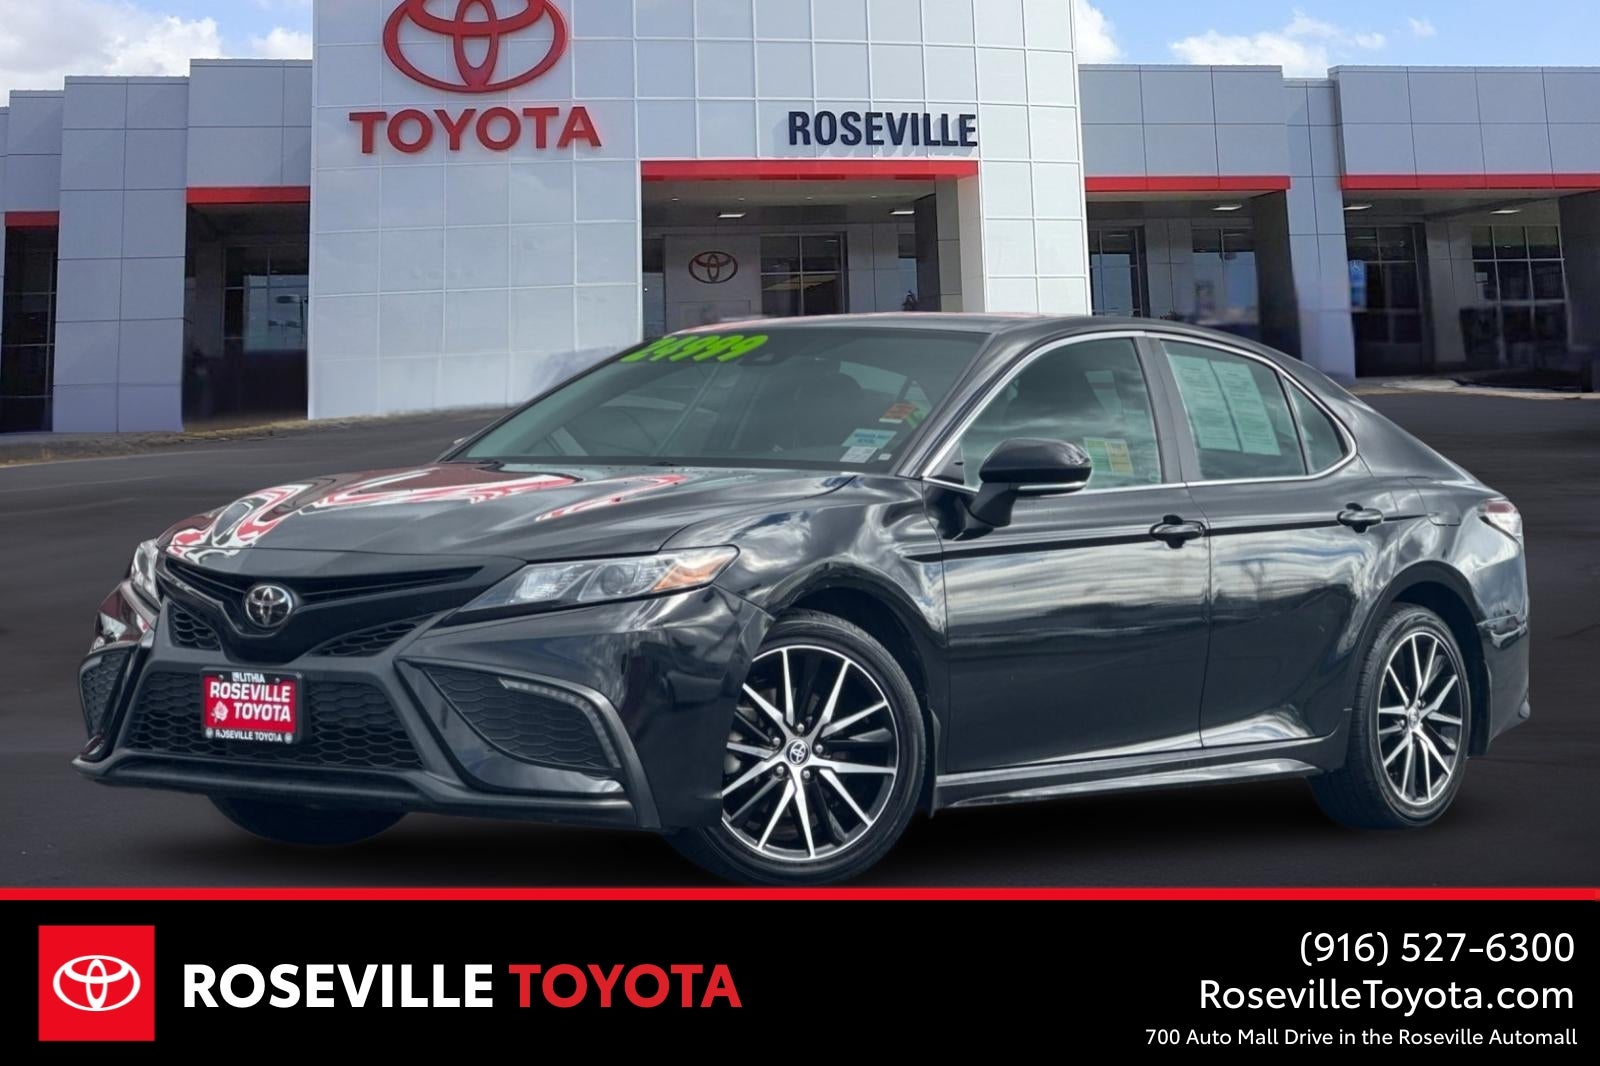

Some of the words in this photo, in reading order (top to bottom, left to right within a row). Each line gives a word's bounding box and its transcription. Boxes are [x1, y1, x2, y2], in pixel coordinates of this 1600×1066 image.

[349, 106, 602, 154] TOYOTA
[788, 111, 978, 147] ROSEVILLE
[239, 672, 266, 683] LITHIA
[210, 682, 291, 702] ROSEVILLE
[234, 701, 291, 722] TOYOTA
[215, 730, 253, 740] ROSEVILLE
[254, 731, 283, 742] TOYOTA
